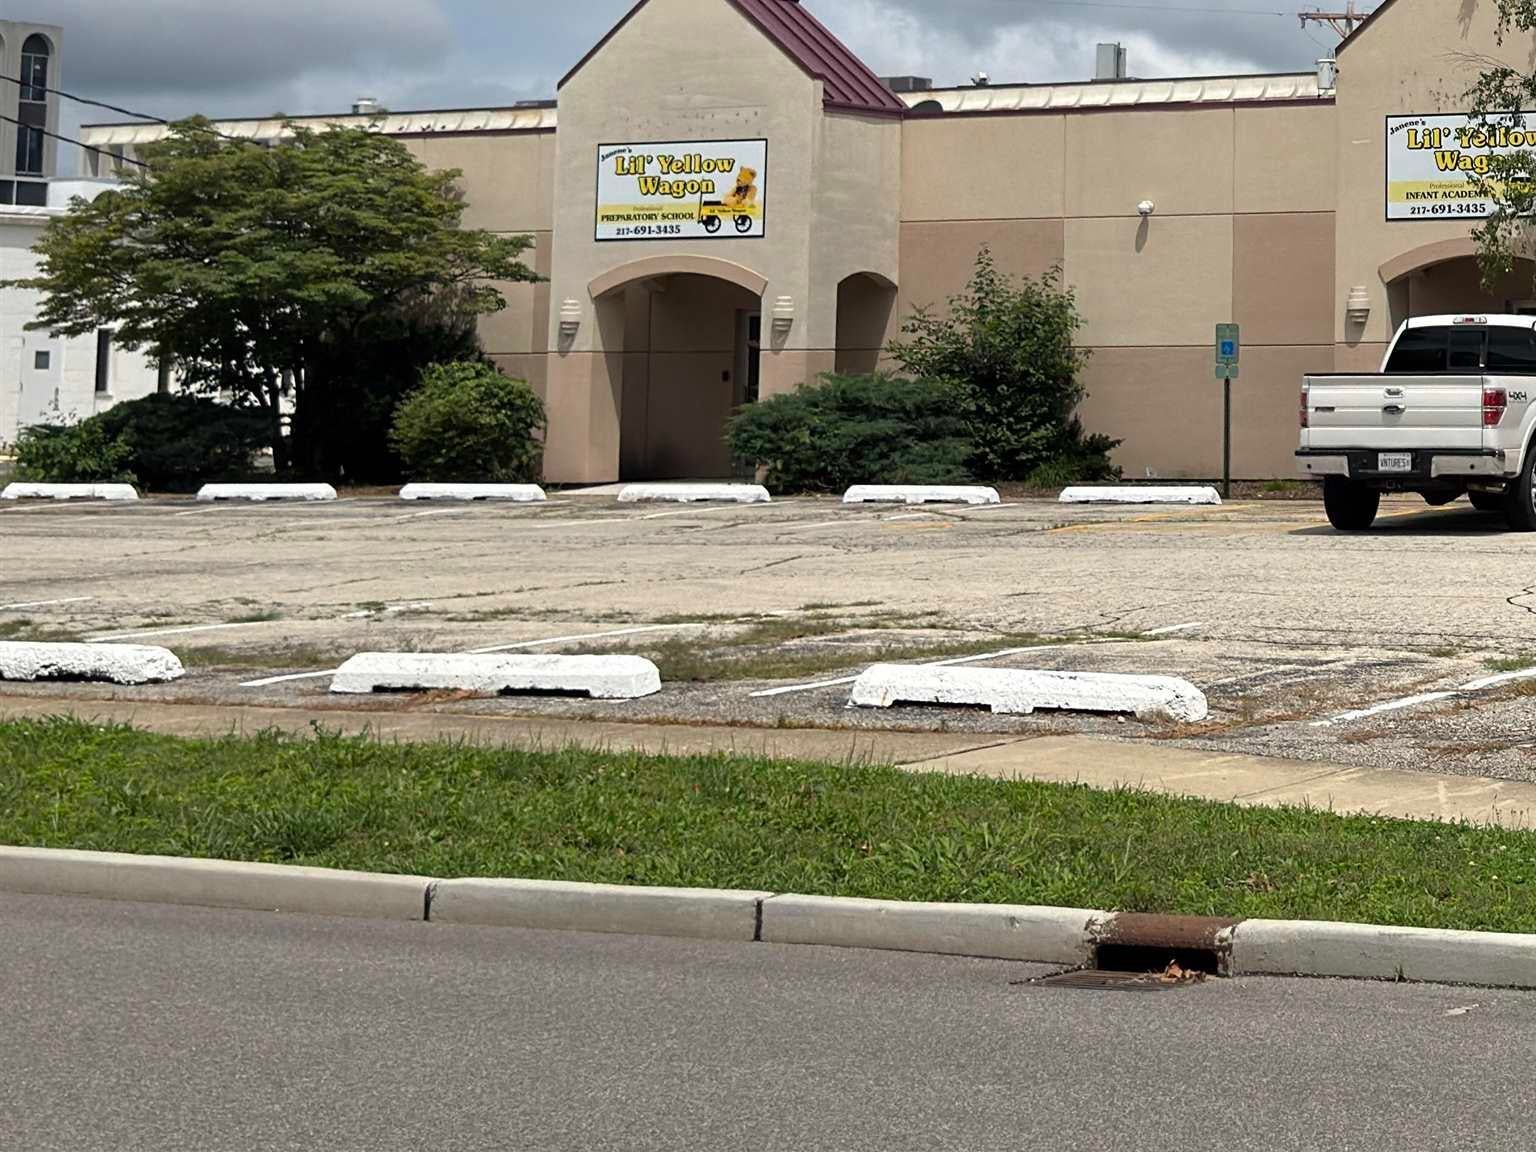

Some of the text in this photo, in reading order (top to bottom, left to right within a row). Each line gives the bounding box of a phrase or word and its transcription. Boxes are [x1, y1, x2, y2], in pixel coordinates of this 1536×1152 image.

[1390, 118, 1427, 135] Janene's
[1407, 127, 1450, 149] Lil'
[615, 153, 735, 176] Lil' Yellow
[638, 175, 716, 198] Wagon
[1405, 191, 1439, 200] INFANT
[1410, 203, 1486, 215] 217-691-3435
[600, 212, 695, 222] PREPARATORY SCHOOL
[616, 224, 681, 236] 217-691-3435
